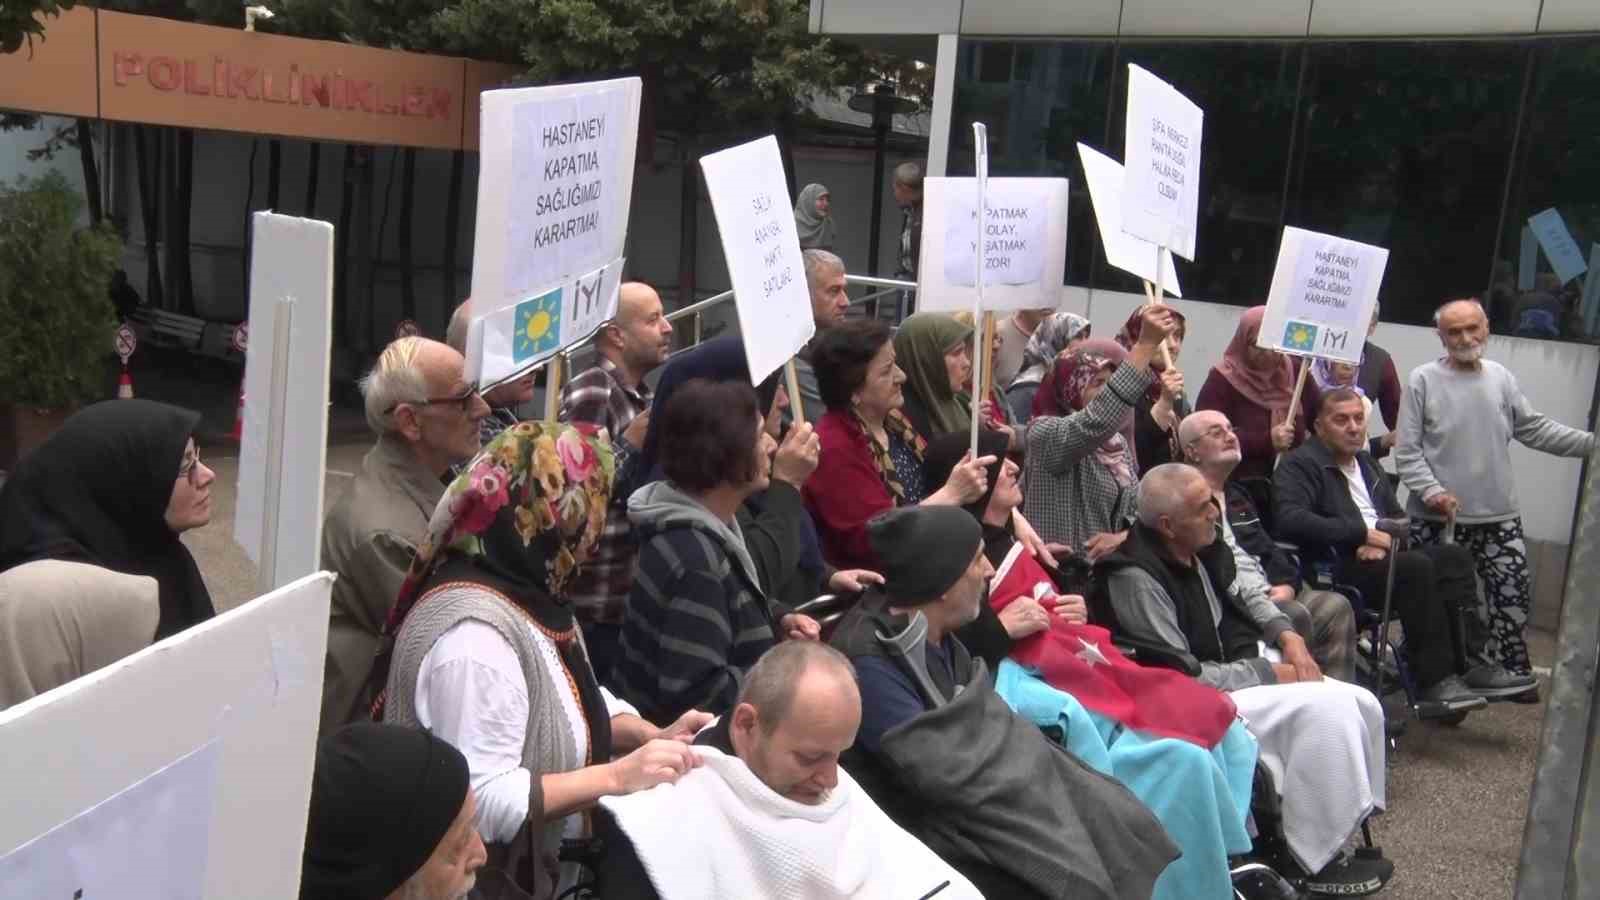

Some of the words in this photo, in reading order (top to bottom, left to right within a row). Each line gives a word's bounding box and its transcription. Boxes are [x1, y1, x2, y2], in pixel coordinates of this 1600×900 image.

[543, 113, 606, 147] HASTANEYİ
[971, 208, 1029, 219] KPATMAK
[534, 211, 599, 249] KARARTMA!
[985, 224, 1018, 237] OLAY,
[970, 239, 1027, 255] YŞATMAK
[985, 256, 1011, 270] ZOR!
[573, 269, 605, 321] İYİ
[1323, 328, 1348, 351] İYİ
